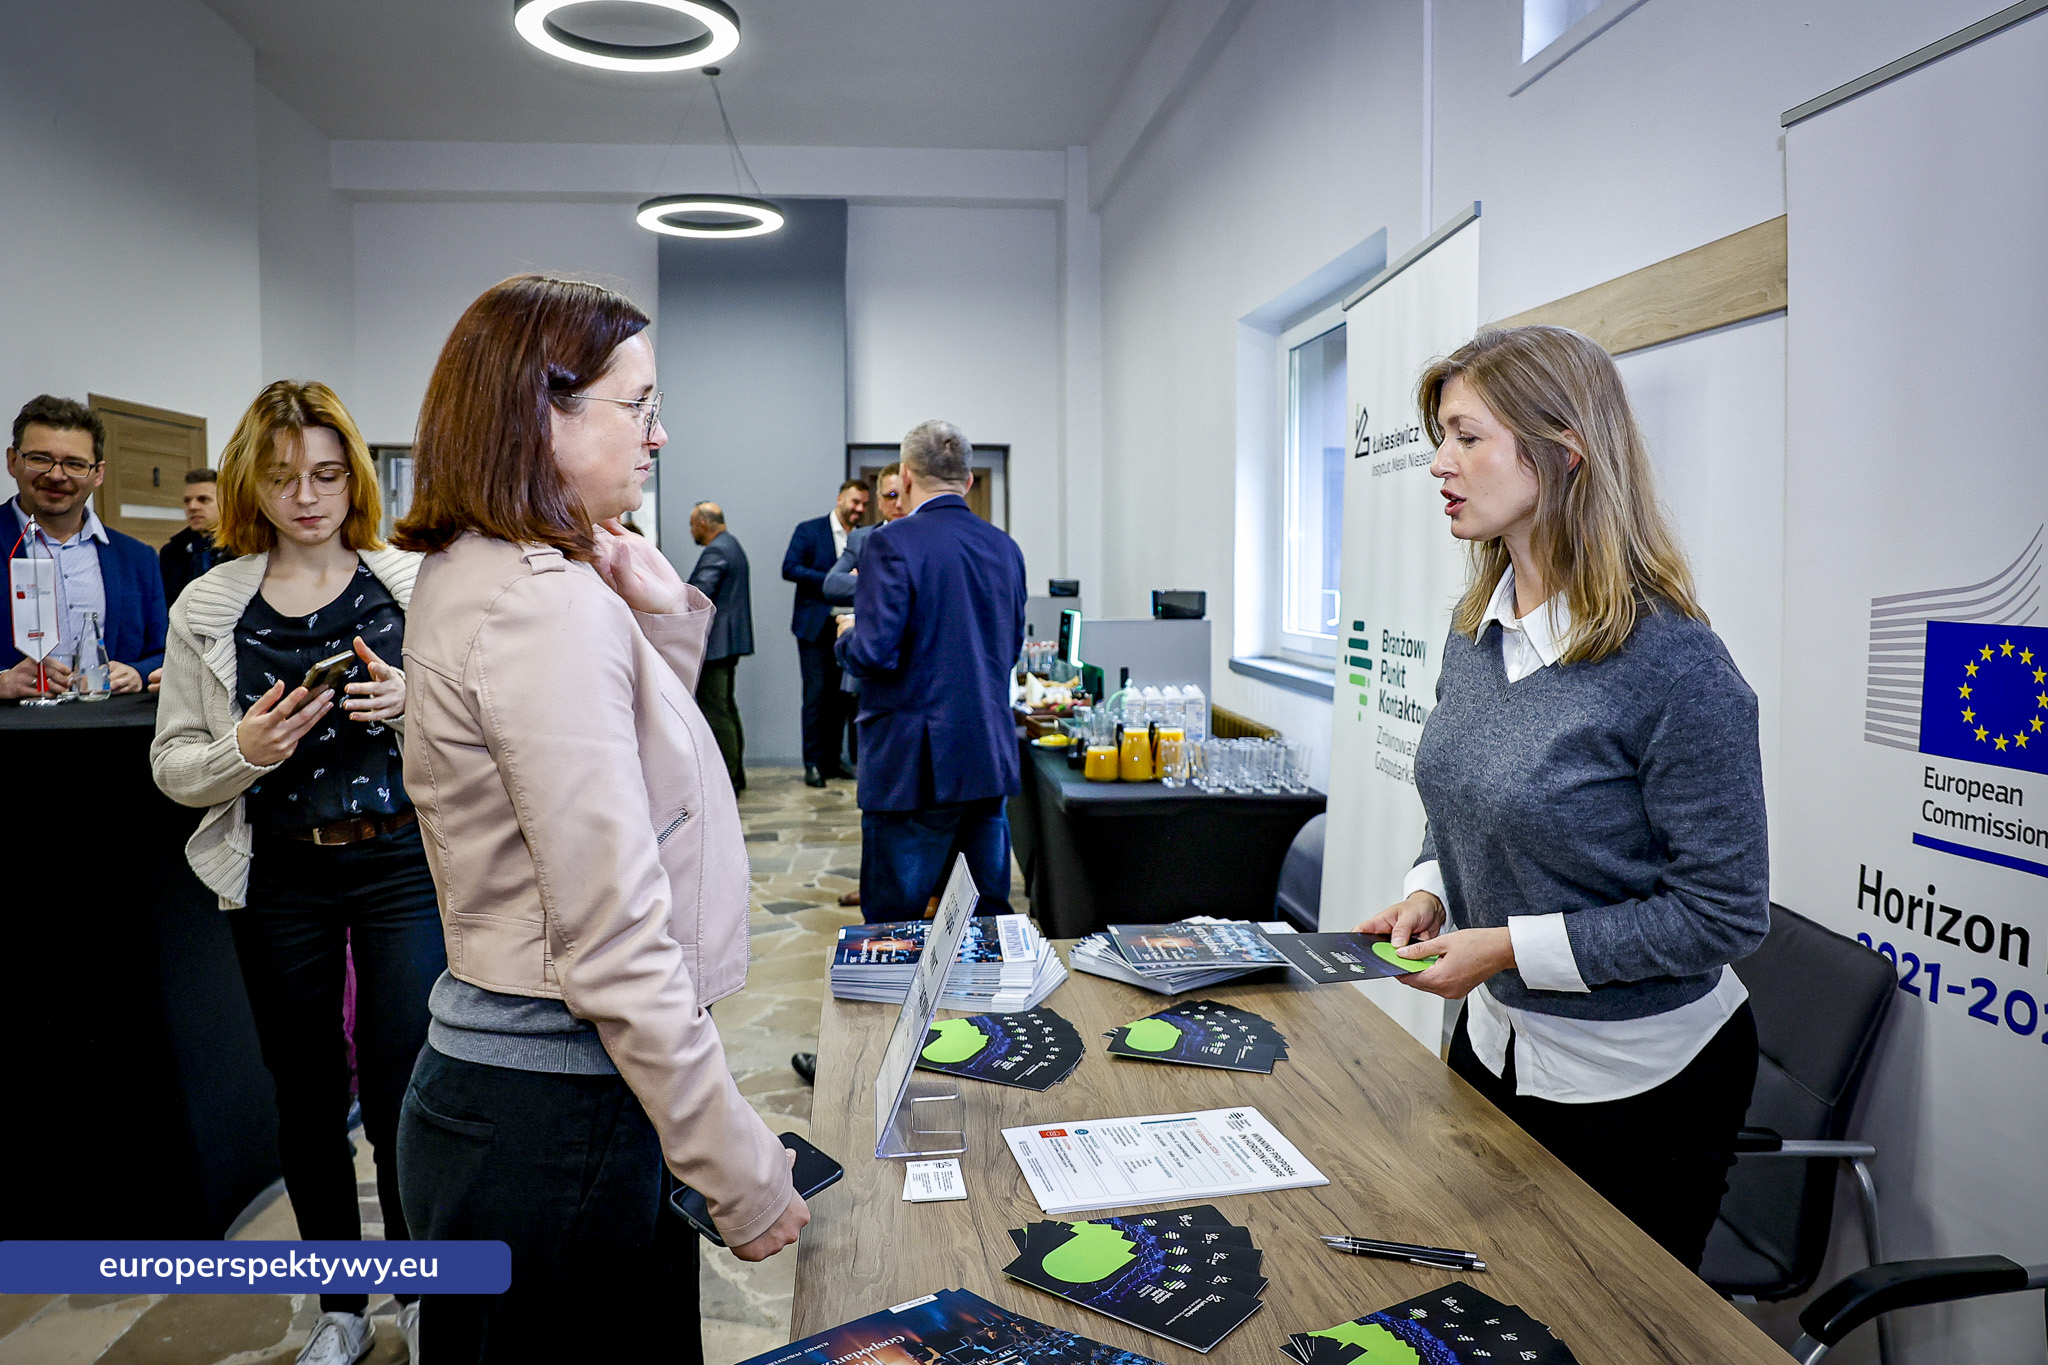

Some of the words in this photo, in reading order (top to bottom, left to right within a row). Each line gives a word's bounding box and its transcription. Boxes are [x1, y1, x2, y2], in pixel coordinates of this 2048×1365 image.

[1373, 423, 1419, 454] Łukasiewicz
[1382, 629, 1427, 667] Branżowy
[1380, 659, 1406, 688] Punkt
[1376, 725, 1418, 757] Zrównoważ
[1924, 766, 2023, 807] European
[1922, 800, 2048, 849] Commission
[1857, 863, 2030, 968] Horizon
